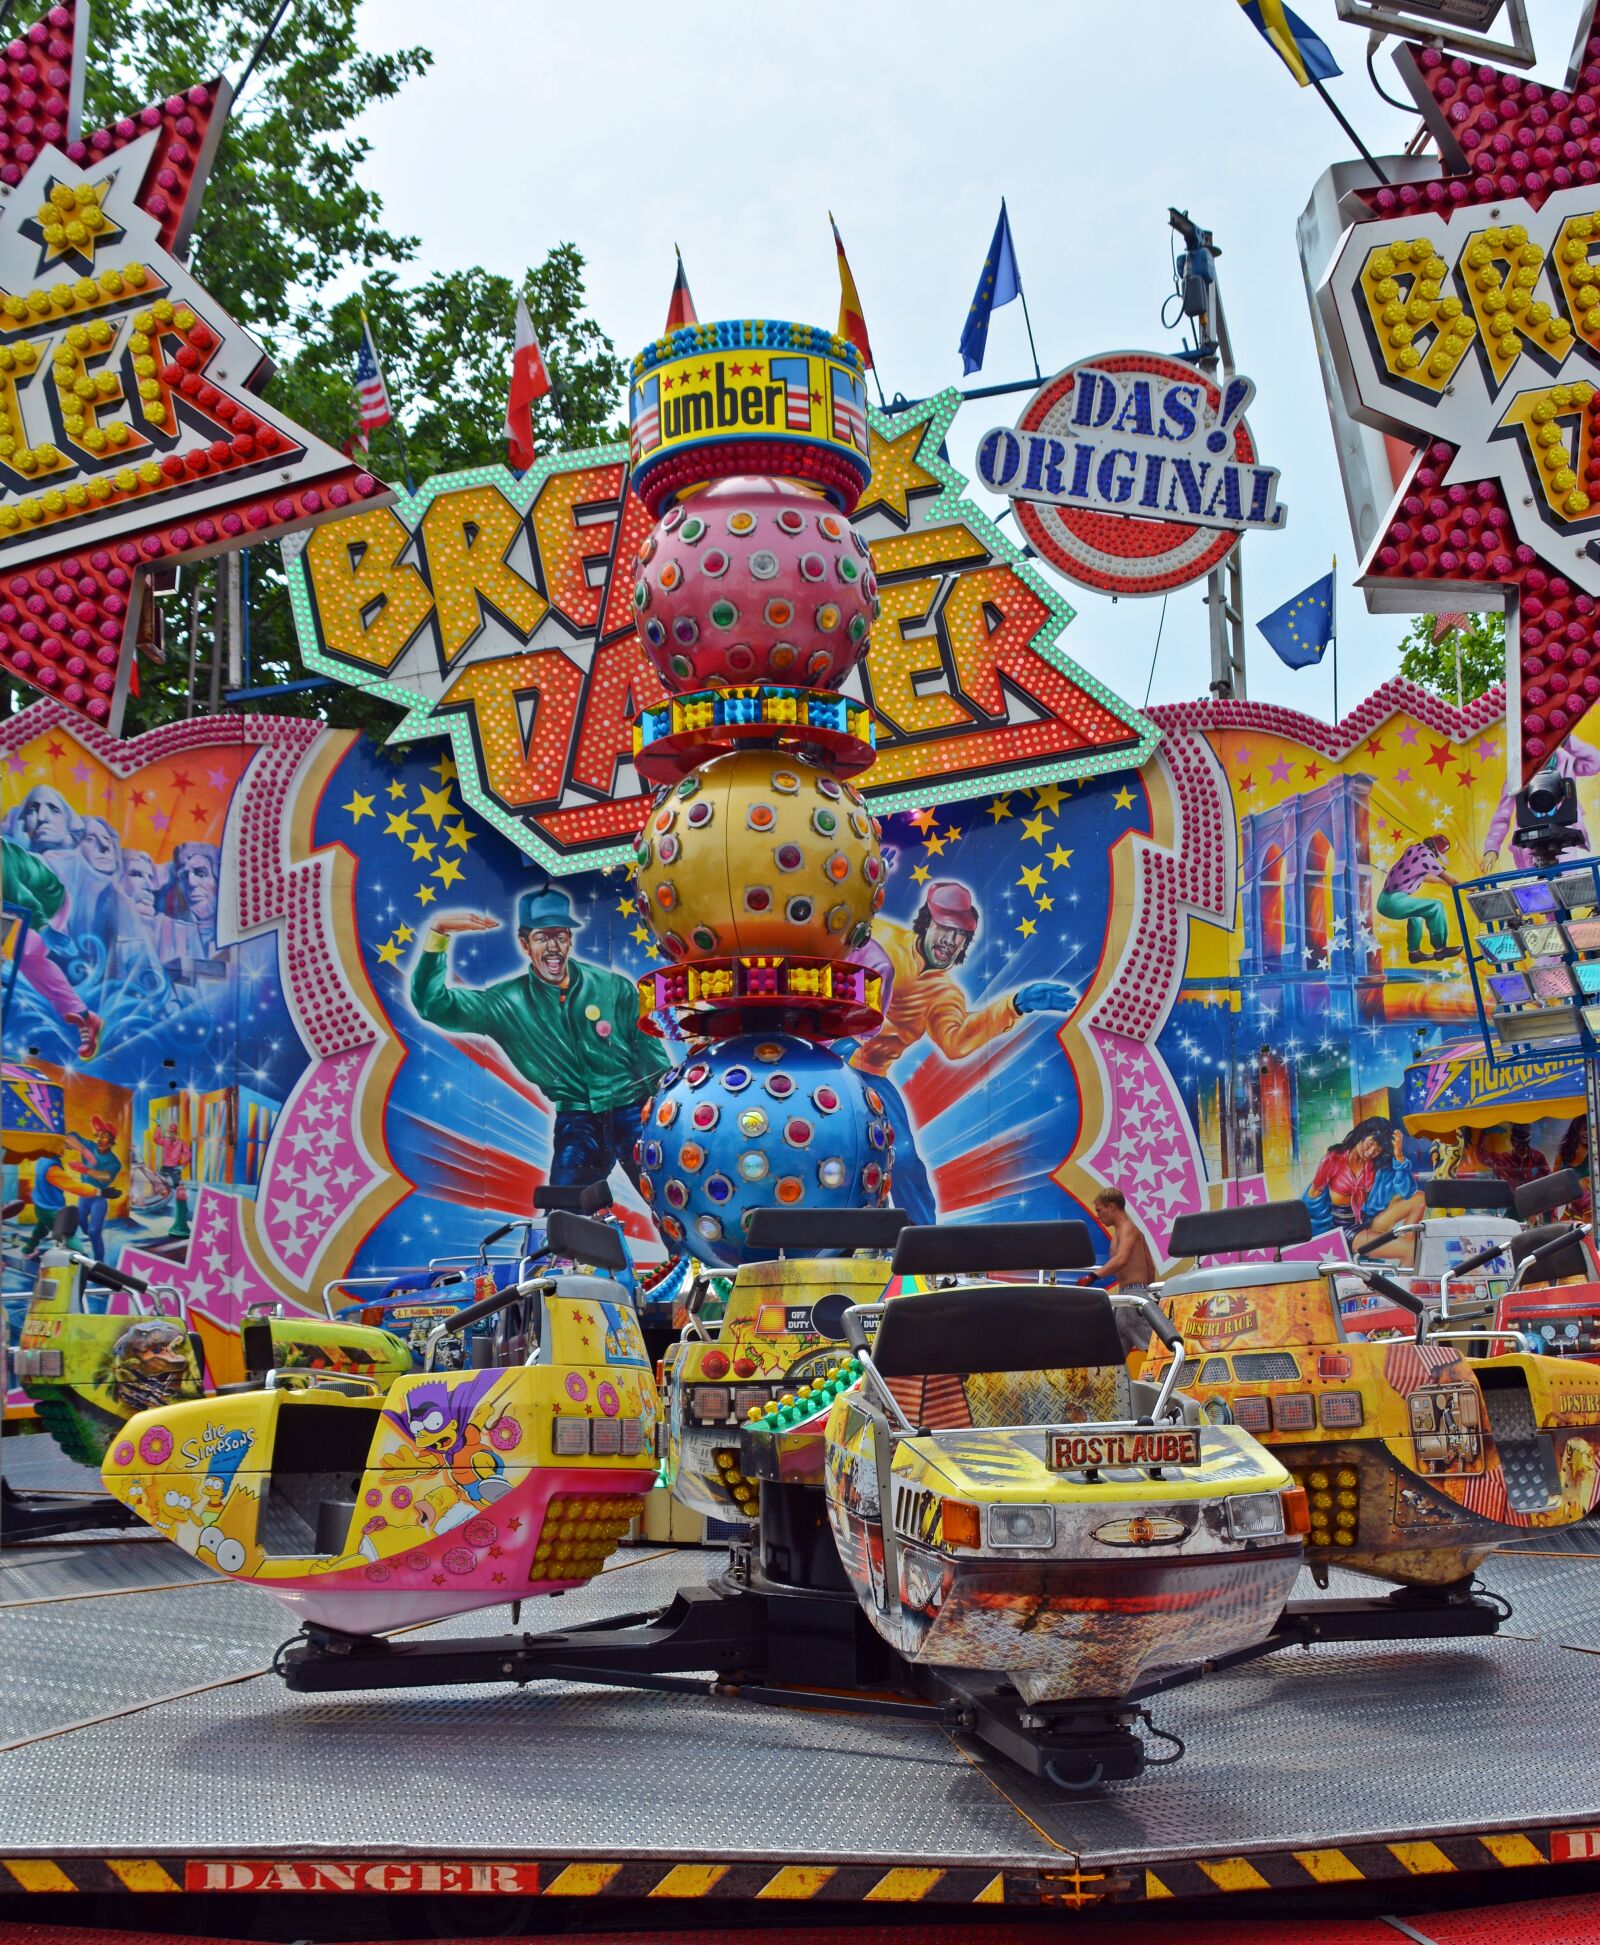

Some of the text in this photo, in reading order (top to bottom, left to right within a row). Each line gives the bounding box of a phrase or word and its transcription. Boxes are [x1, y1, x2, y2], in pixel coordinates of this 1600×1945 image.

[978, 430, 1283, 524] ORIGINAL
[788, 1320, 810, 1329] DUTY
[791, 1311, 807, 1319] OFF
[863, 1320, 880, 1328] DUT
[1185, 1314, 1253, 1336] DESERT RACE
[203, 1421, 226, 1442] die
[1055, 1434, 1195, 1468] ROSTLAUBE
[202, 1863, 524, 1892] DANGER
